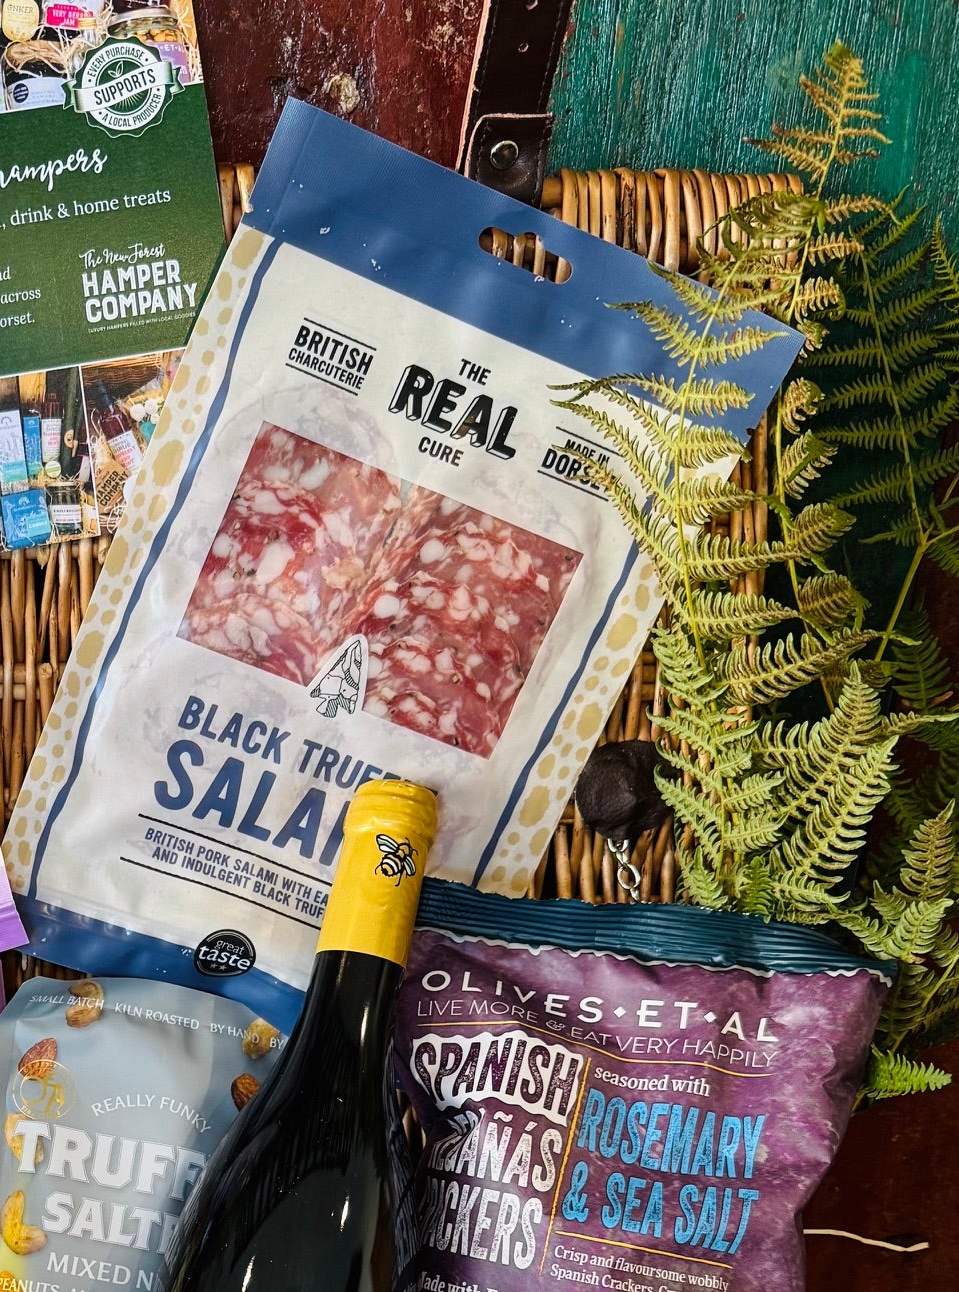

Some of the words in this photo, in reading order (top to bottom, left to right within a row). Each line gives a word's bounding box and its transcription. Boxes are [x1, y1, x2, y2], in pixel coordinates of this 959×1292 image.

[90, 54, 105, 78] EVERY
[105, 46, 145, 60] PURCHASE
[94, 68, 156, 105] SUPPORTS
[109, 116, 132, 127] LOCAL
[133, 94, 162, 126] PRODUCER
[10, 208, 53, 226] drink
[58, 203, 70, 217] &
[74, 197, 119, 216] home
[124, 189, 171, 208] treats
[82, 260, 181, 298] HAMPER
[85, 283, 197, 323] COMPANY
[289, 348, 364, 390] CHARCUTERIE
[294, 325, 373, 375] BRITISH
[389, 364, 518, 460] REAL
[178, 696, 291, 764] BLACK
[145, 828, 194, 854] BRITISH
[196, 846, 229, 867] PORK
[234, 858, 279, 886] SALAMI
[282, 878, 312, 898] WITH
[152, 847, 177, 864] AND
[182, 858, 251, 890] INDULGENT
[253, 884, 291, 908] BLACK
[198, 945, 251, 970] taste
[417, 1000, 464, 1019] LIVE
[469, 1000, 538, 1025] MORE
[546, 1019, 564, 1033] &
[571, 1026, 611, 1047] EAT
[615, 1035, 677, 1055] VERY
[682, 1040, 779, 1068] HAPPILY
[413, 1037, 584, 1118] SPANISH
[594, 1065, 669, 1092] seasoned
[671, 1076, 710, 1098] with
[92, 1094, 156, 1117] REALLY
[159, 1097, 211, 1133] FUNKY
[577, 1088, 766, 1179] ROSEMARY
[562, 1162, 589, 1223] &
[601, 1172, 662, 1240] SEA
[673, 1184, 760, 1255] SALT
[47, 1251, 131, 1286] MIXED
